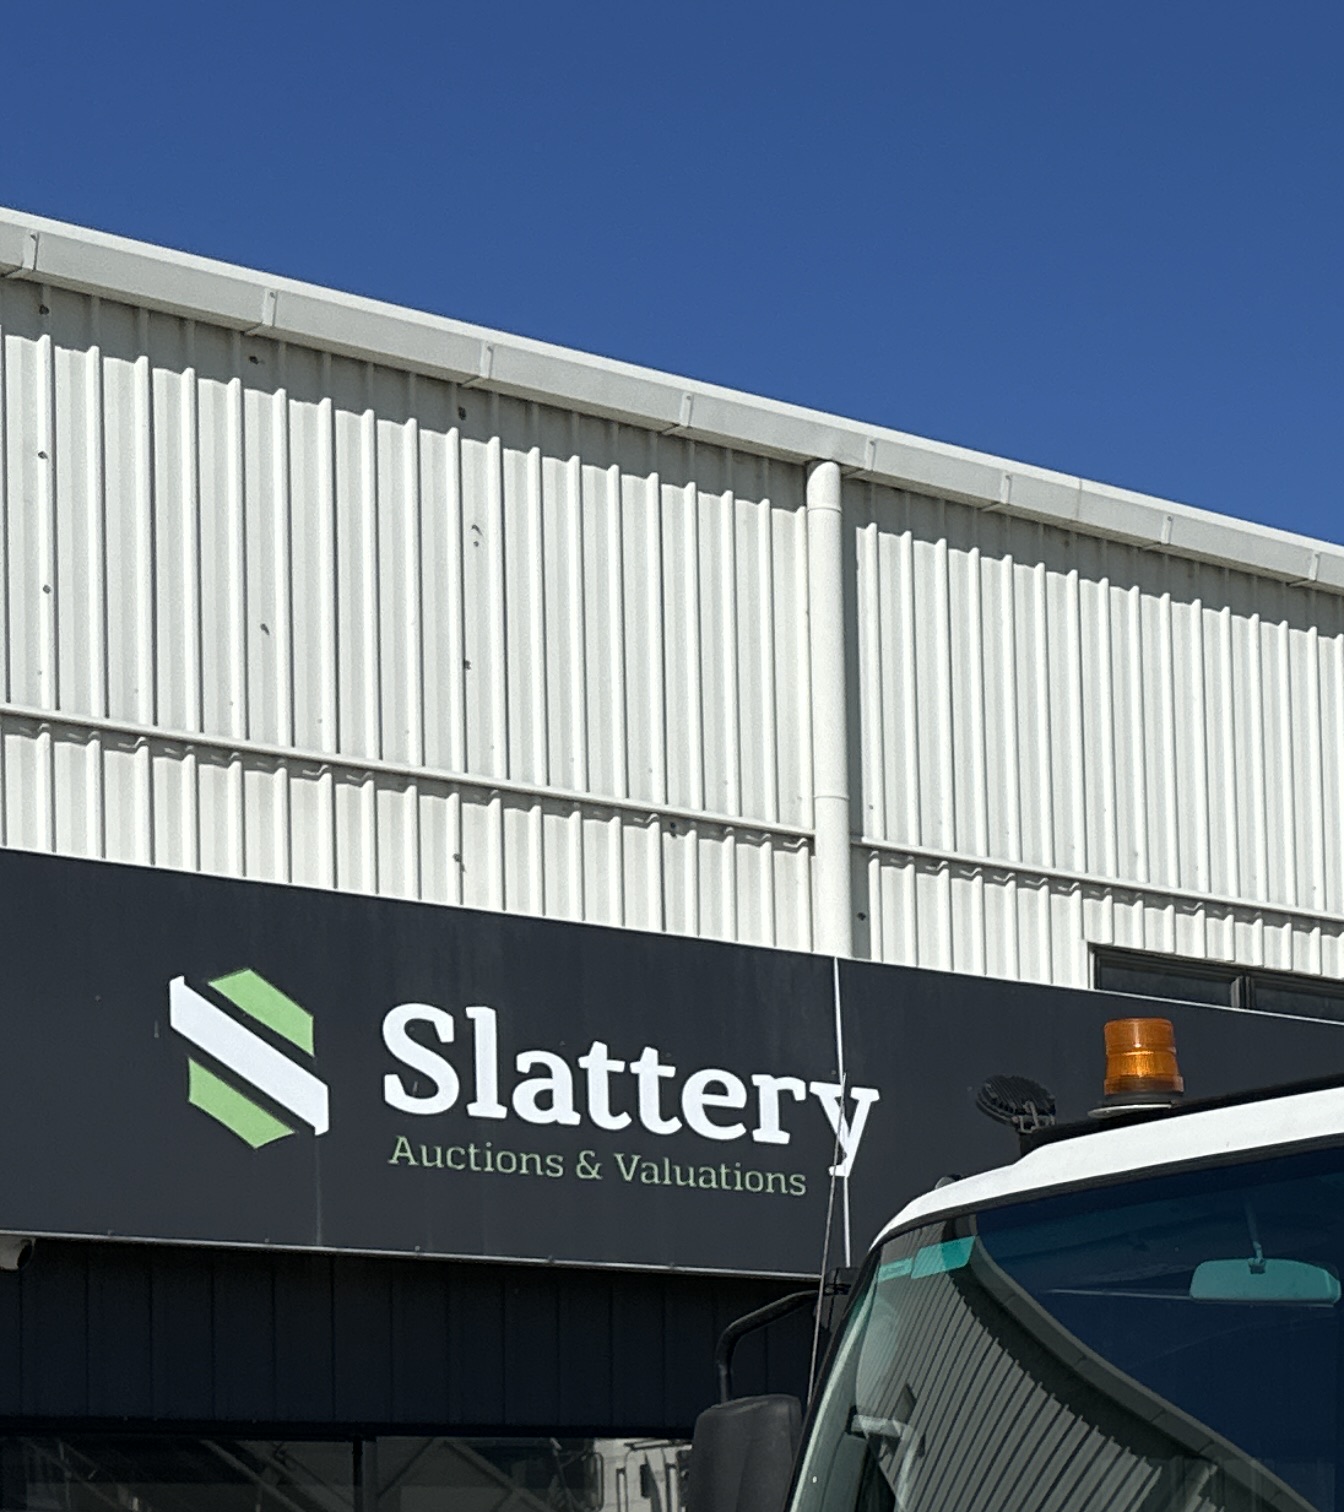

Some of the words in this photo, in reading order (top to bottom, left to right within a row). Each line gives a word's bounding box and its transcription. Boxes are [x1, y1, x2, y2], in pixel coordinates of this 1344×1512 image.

[382, 1002, 880, 1177] Slattery
[387, 1135, 564, 1178] Auctions
[575, 1150, 603, 1180] &
[614, 1152, 807, 1197] Valuations
